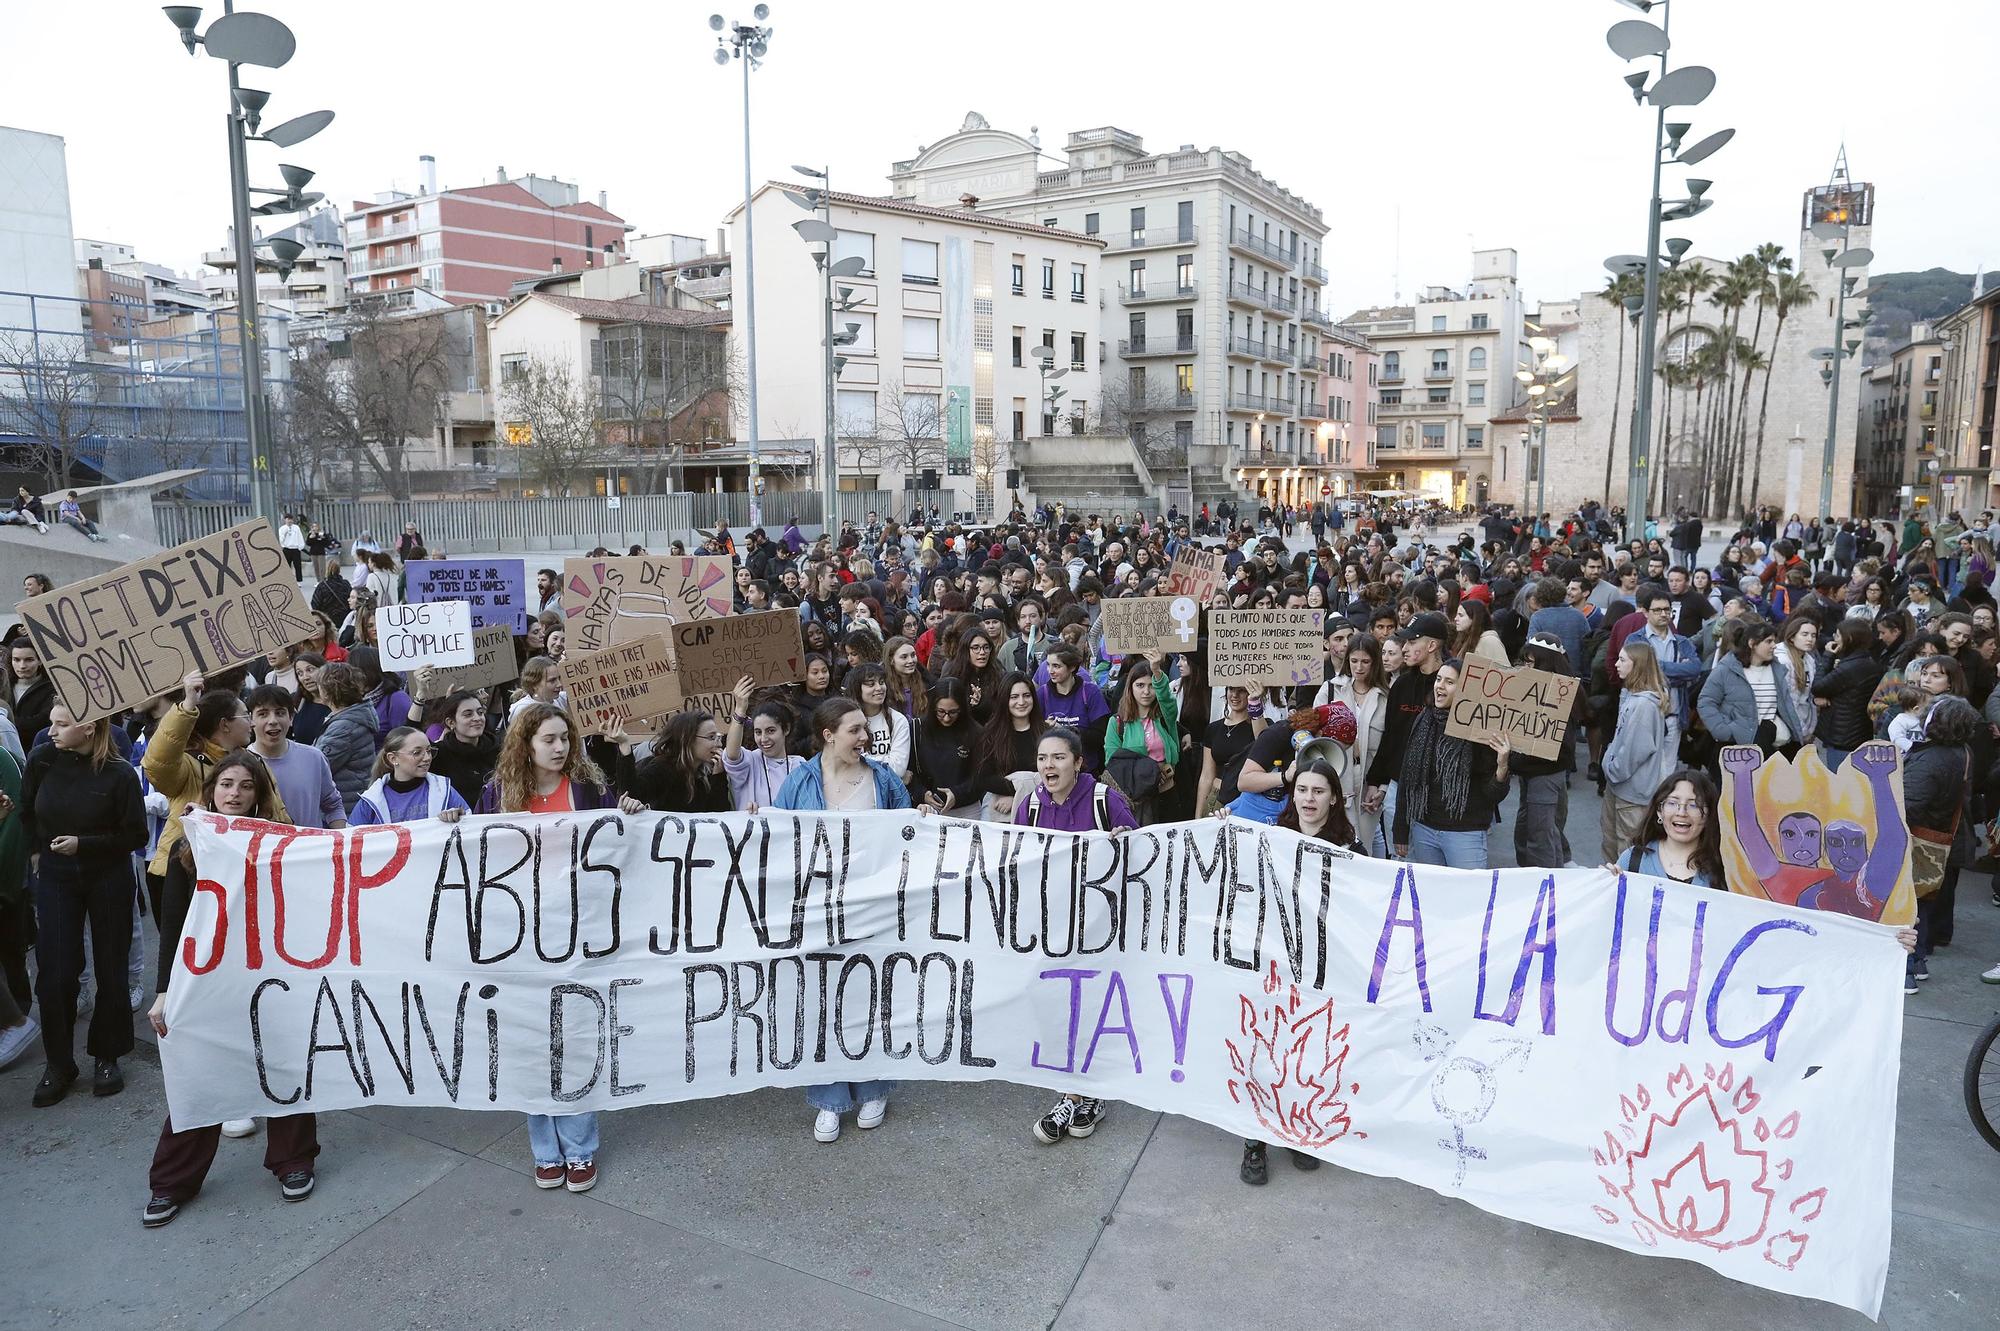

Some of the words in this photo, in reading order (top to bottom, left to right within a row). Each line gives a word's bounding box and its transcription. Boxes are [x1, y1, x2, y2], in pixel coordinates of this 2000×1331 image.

[470, 569, 481, 579] DE
[1192, 569, 1209, 581] NO
[440, 582, 460, 592] TOTS
[464, 581, 477, 592] ELS
[494, 595, 511, 605] QUE
[578, 568, 624, 651] HARTAS
[640, 560, 670, 590] DE
[22, 596, 87, 661] NO
[80, 576, 138, 640] ET
[387, 605, 430, 626] UDG
[1216, 613, 1226, 624] EL
[1231, 613, 1260, 623] PUNTO
[1262, 613, 1274, 624] NO
[1276, 613, 1286, 623] ES
[1290, 614, 1306, 623] QUE
[386, 628, 465, 659] CÒMPLICE
[473, 631, 508, 649] ONTRA
[681, 625, 715, 646] CAP
[1214, 629, 1239, 638] TODOS
[1243, 629, 1257, 637] LOS
[1262, 629, 1295, 637] HOMBRES
[712, 642, 764, 665] SENSE
[1216, 642, 1227, 650] EL
[1232, 642, 1257, 650] PUNTO
[564, 659, 589, 678] ENS
[595, 652, 618, 671] HAN
[620, 644, 646, 663] TRET
[1233, 653, 1267, 661] MUJERES
[569, 677, 595, 697] TANT
[600, 672, 620, 689] QUE
[624, 665, 643, 682] ENS
[645, 659, 671, 677] HAN
[1213, 663, 1274, 677] ACOSADAS
[1461, 664, 1516, 701] FOC
[1521, 682, 1558, 709] AL
[576, 692, 612, 713] ACABAT
[579, 713, 593, 728] LA
[183, 815, 412, 976] STOP
[649, 814, 875, 956] SEXUAL
[1366, 864, 1432, 1013] A
[1473, 869, 1556, 1036] LA
[1604, 874, 1818, 1063] UdG
[549, 977, 647, 1103] DE
[685, 951, 997, 1083] PROTOCOL
[1033, 968, 1192, 1083] JA!
